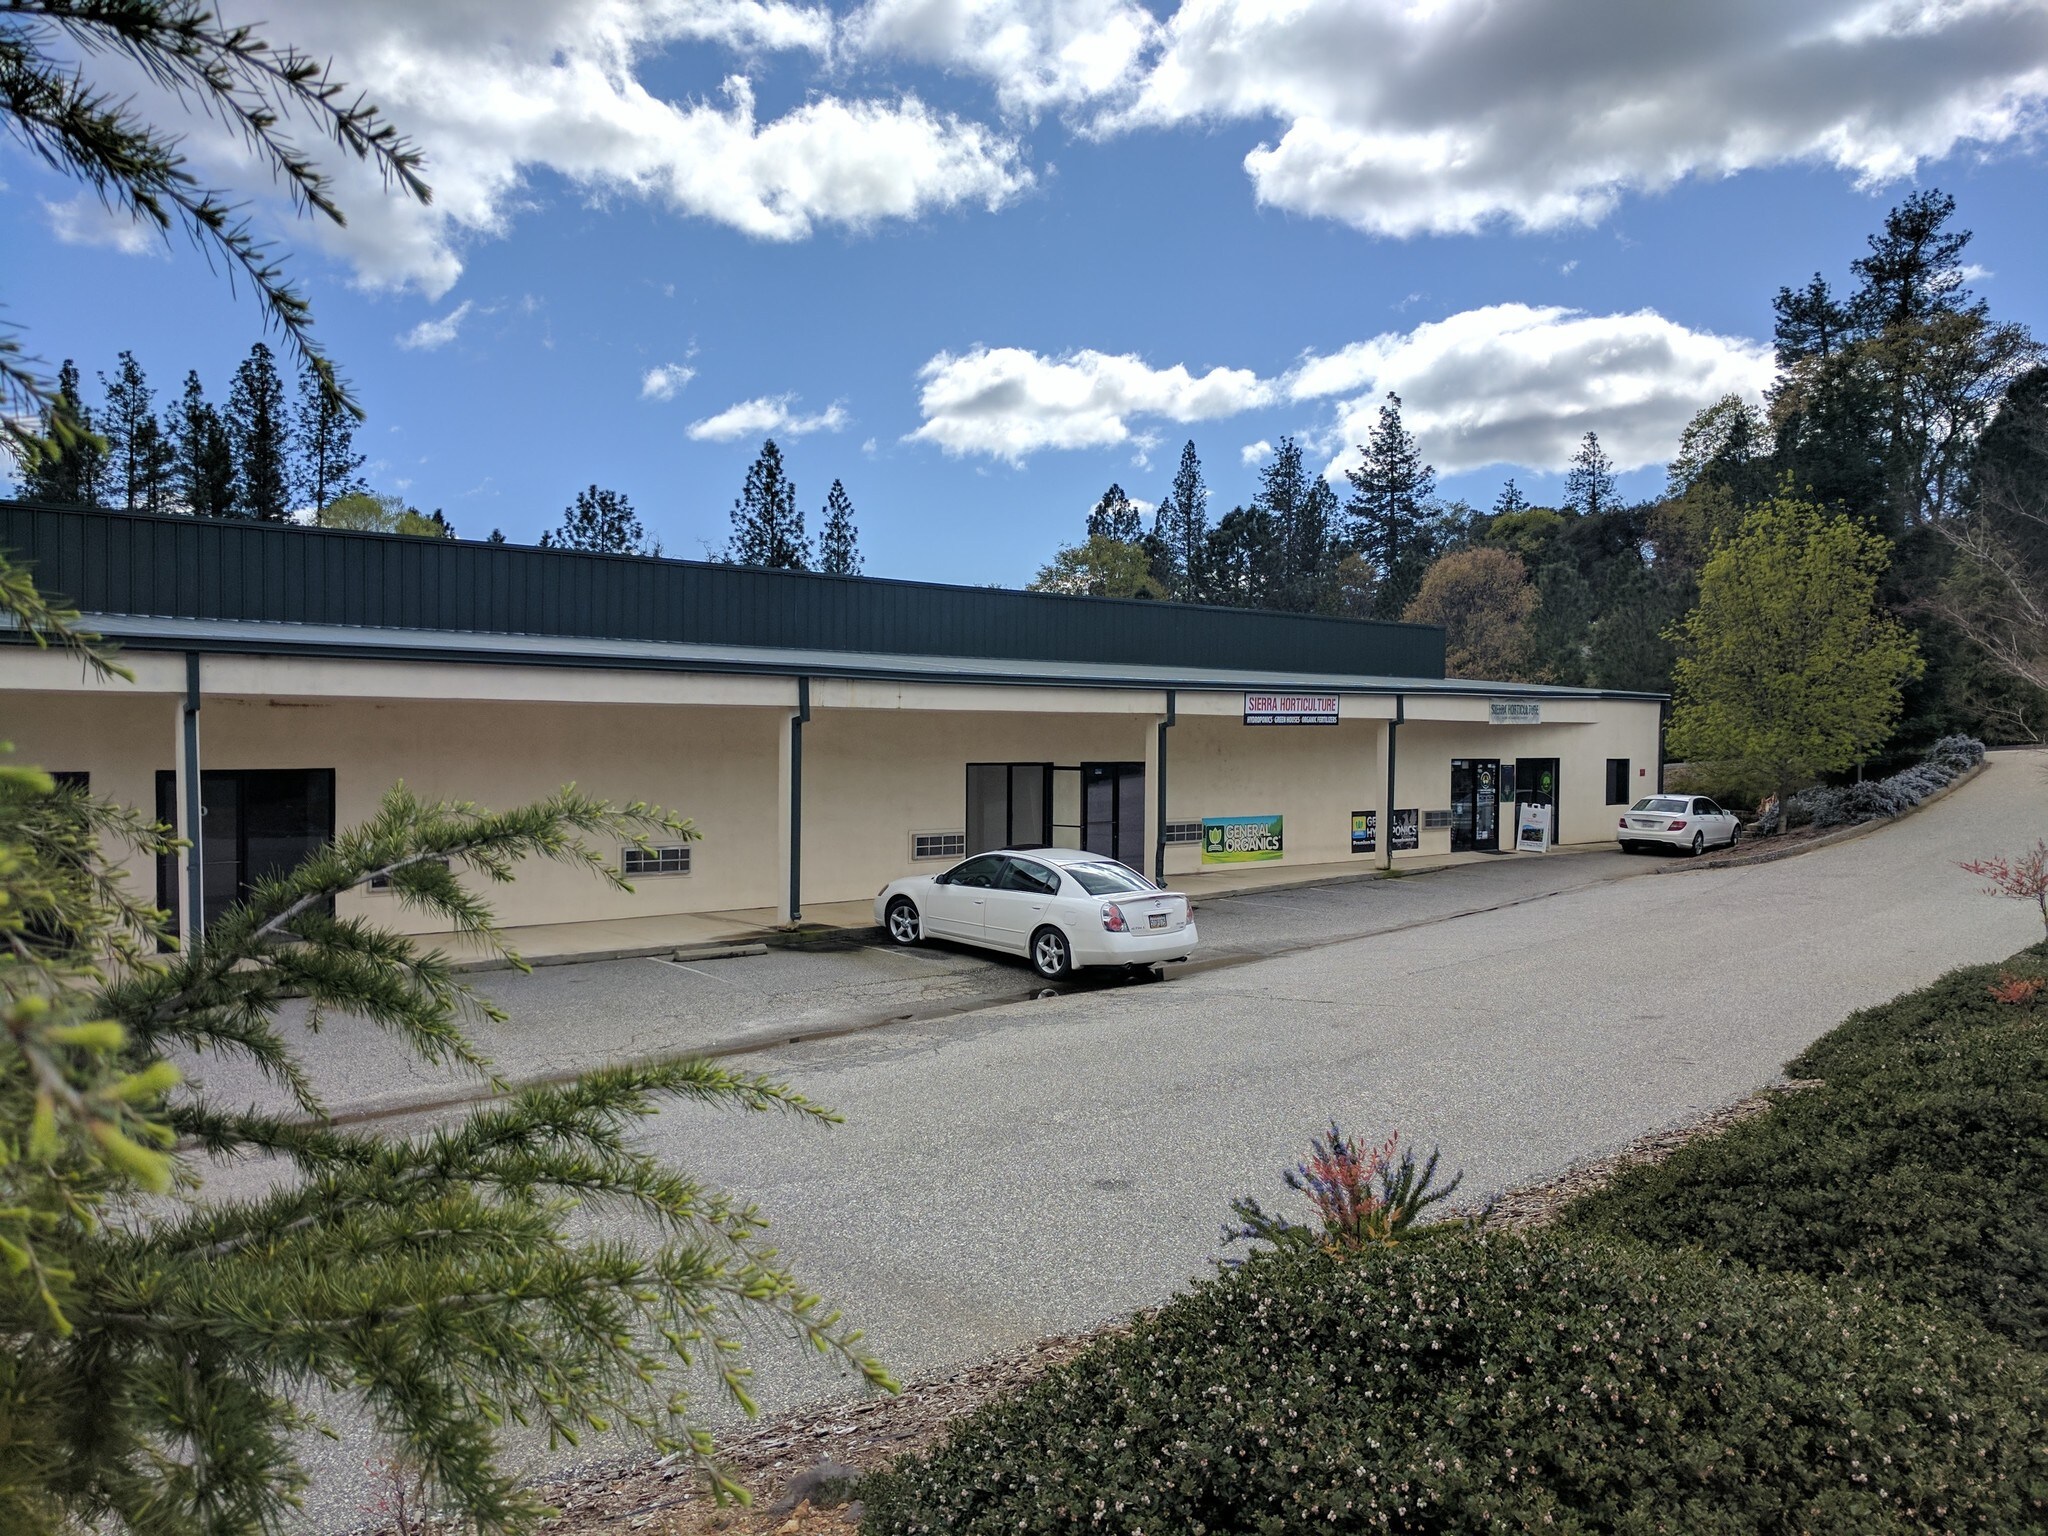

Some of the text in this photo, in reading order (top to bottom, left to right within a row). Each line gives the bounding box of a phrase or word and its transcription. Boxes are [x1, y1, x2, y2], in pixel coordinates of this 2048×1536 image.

[1248, 697, 1336, 711] SIERRA HORTICULTURE
[1226, 823, 1271, 839] GENERAL
[1226, 836, 1279, 852] ORGANICS
